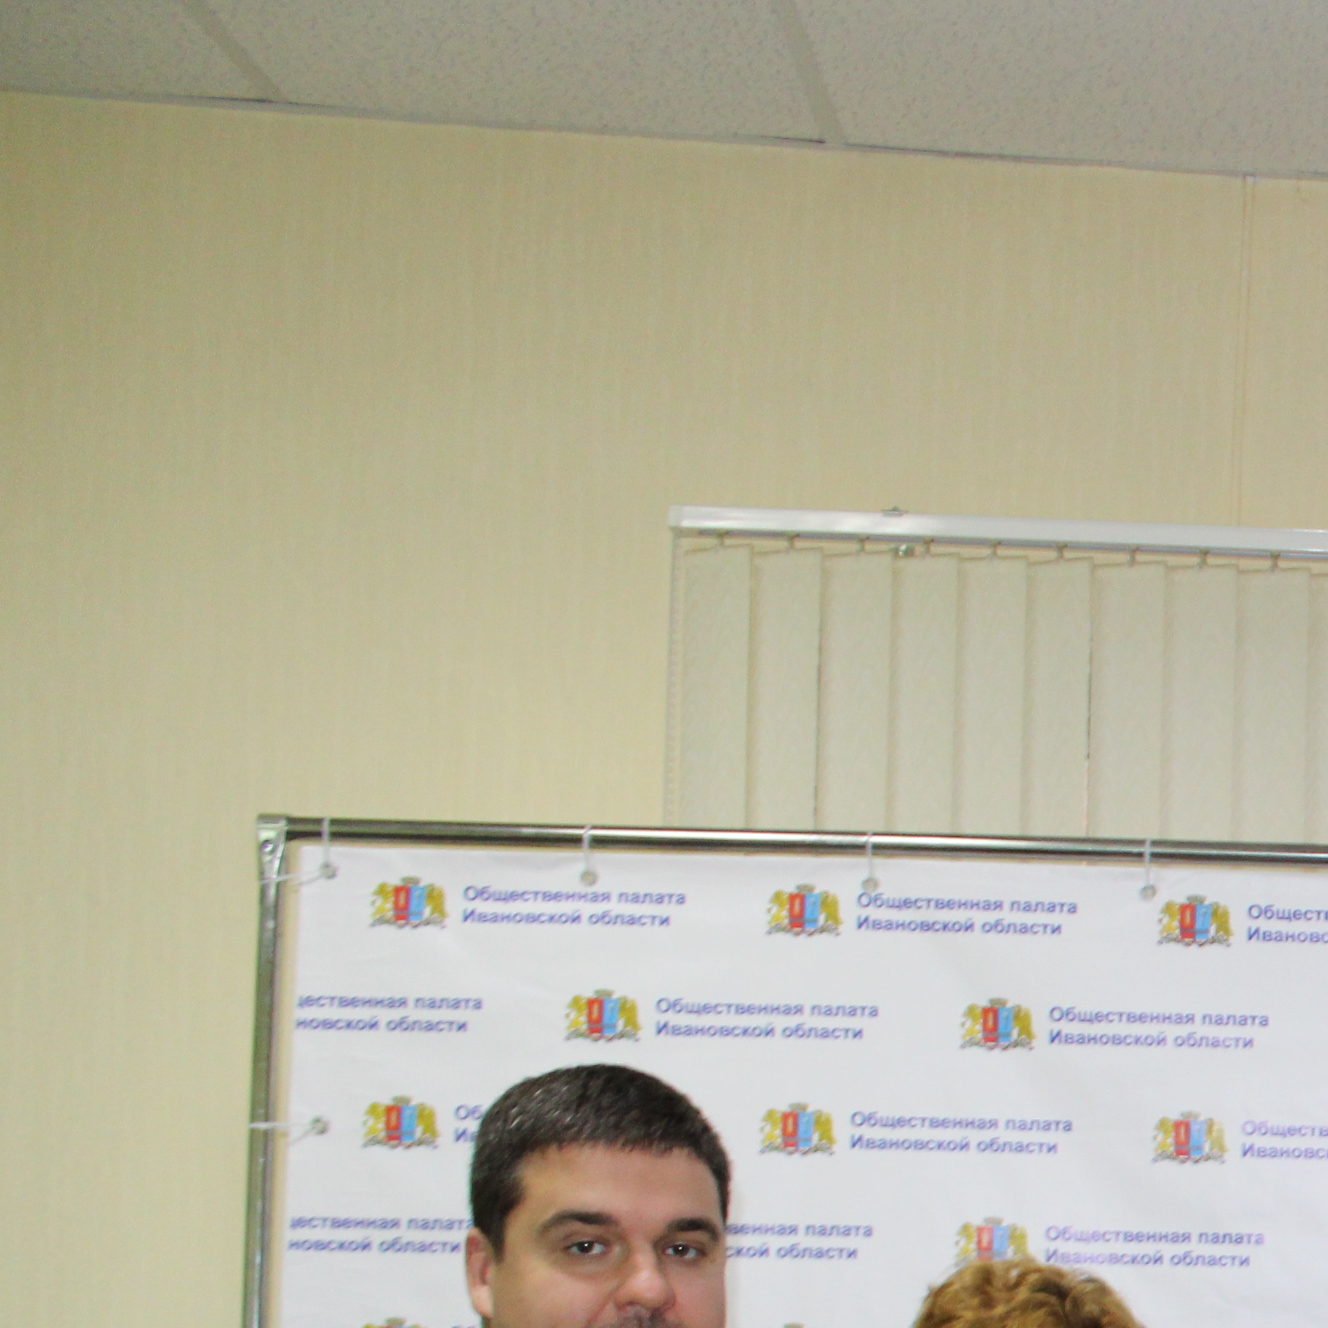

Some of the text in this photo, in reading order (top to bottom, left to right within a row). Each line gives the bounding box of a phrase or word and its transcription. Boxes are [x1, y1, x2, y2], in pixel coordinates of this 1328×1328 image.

[464, 886, 687, 906] Общественная палата
[856, 892, 1077, 915] Общественная палата
[462, 909, 671, 927] Ивановской области
[856, 916, 1062, 935] Ивановской области
[414, 997, 484, 1011] палата
[655, 998, 879, 1018] Общественная палата
[387, 1016, 469, 1033] области
[1049, 1006, 1270, 1027] Общественная палата
[655, 1021, 864, 1040] Ивановской области
[1048, 1029, 1253, 1049] Ивановской области
[850, 1111, 1073, 1133] Общественная палата
[850, 1135, 1058, 1154] Ивановской области
[804, 1224, 873, 1238] палата
[1044, 1225, 1266, 1246] Общественная палата
[380, 1238, 462, 1254] области
[775, 1244, 858, 1260] области
[1046, 1249, 1250, 1269] Ивановской области
